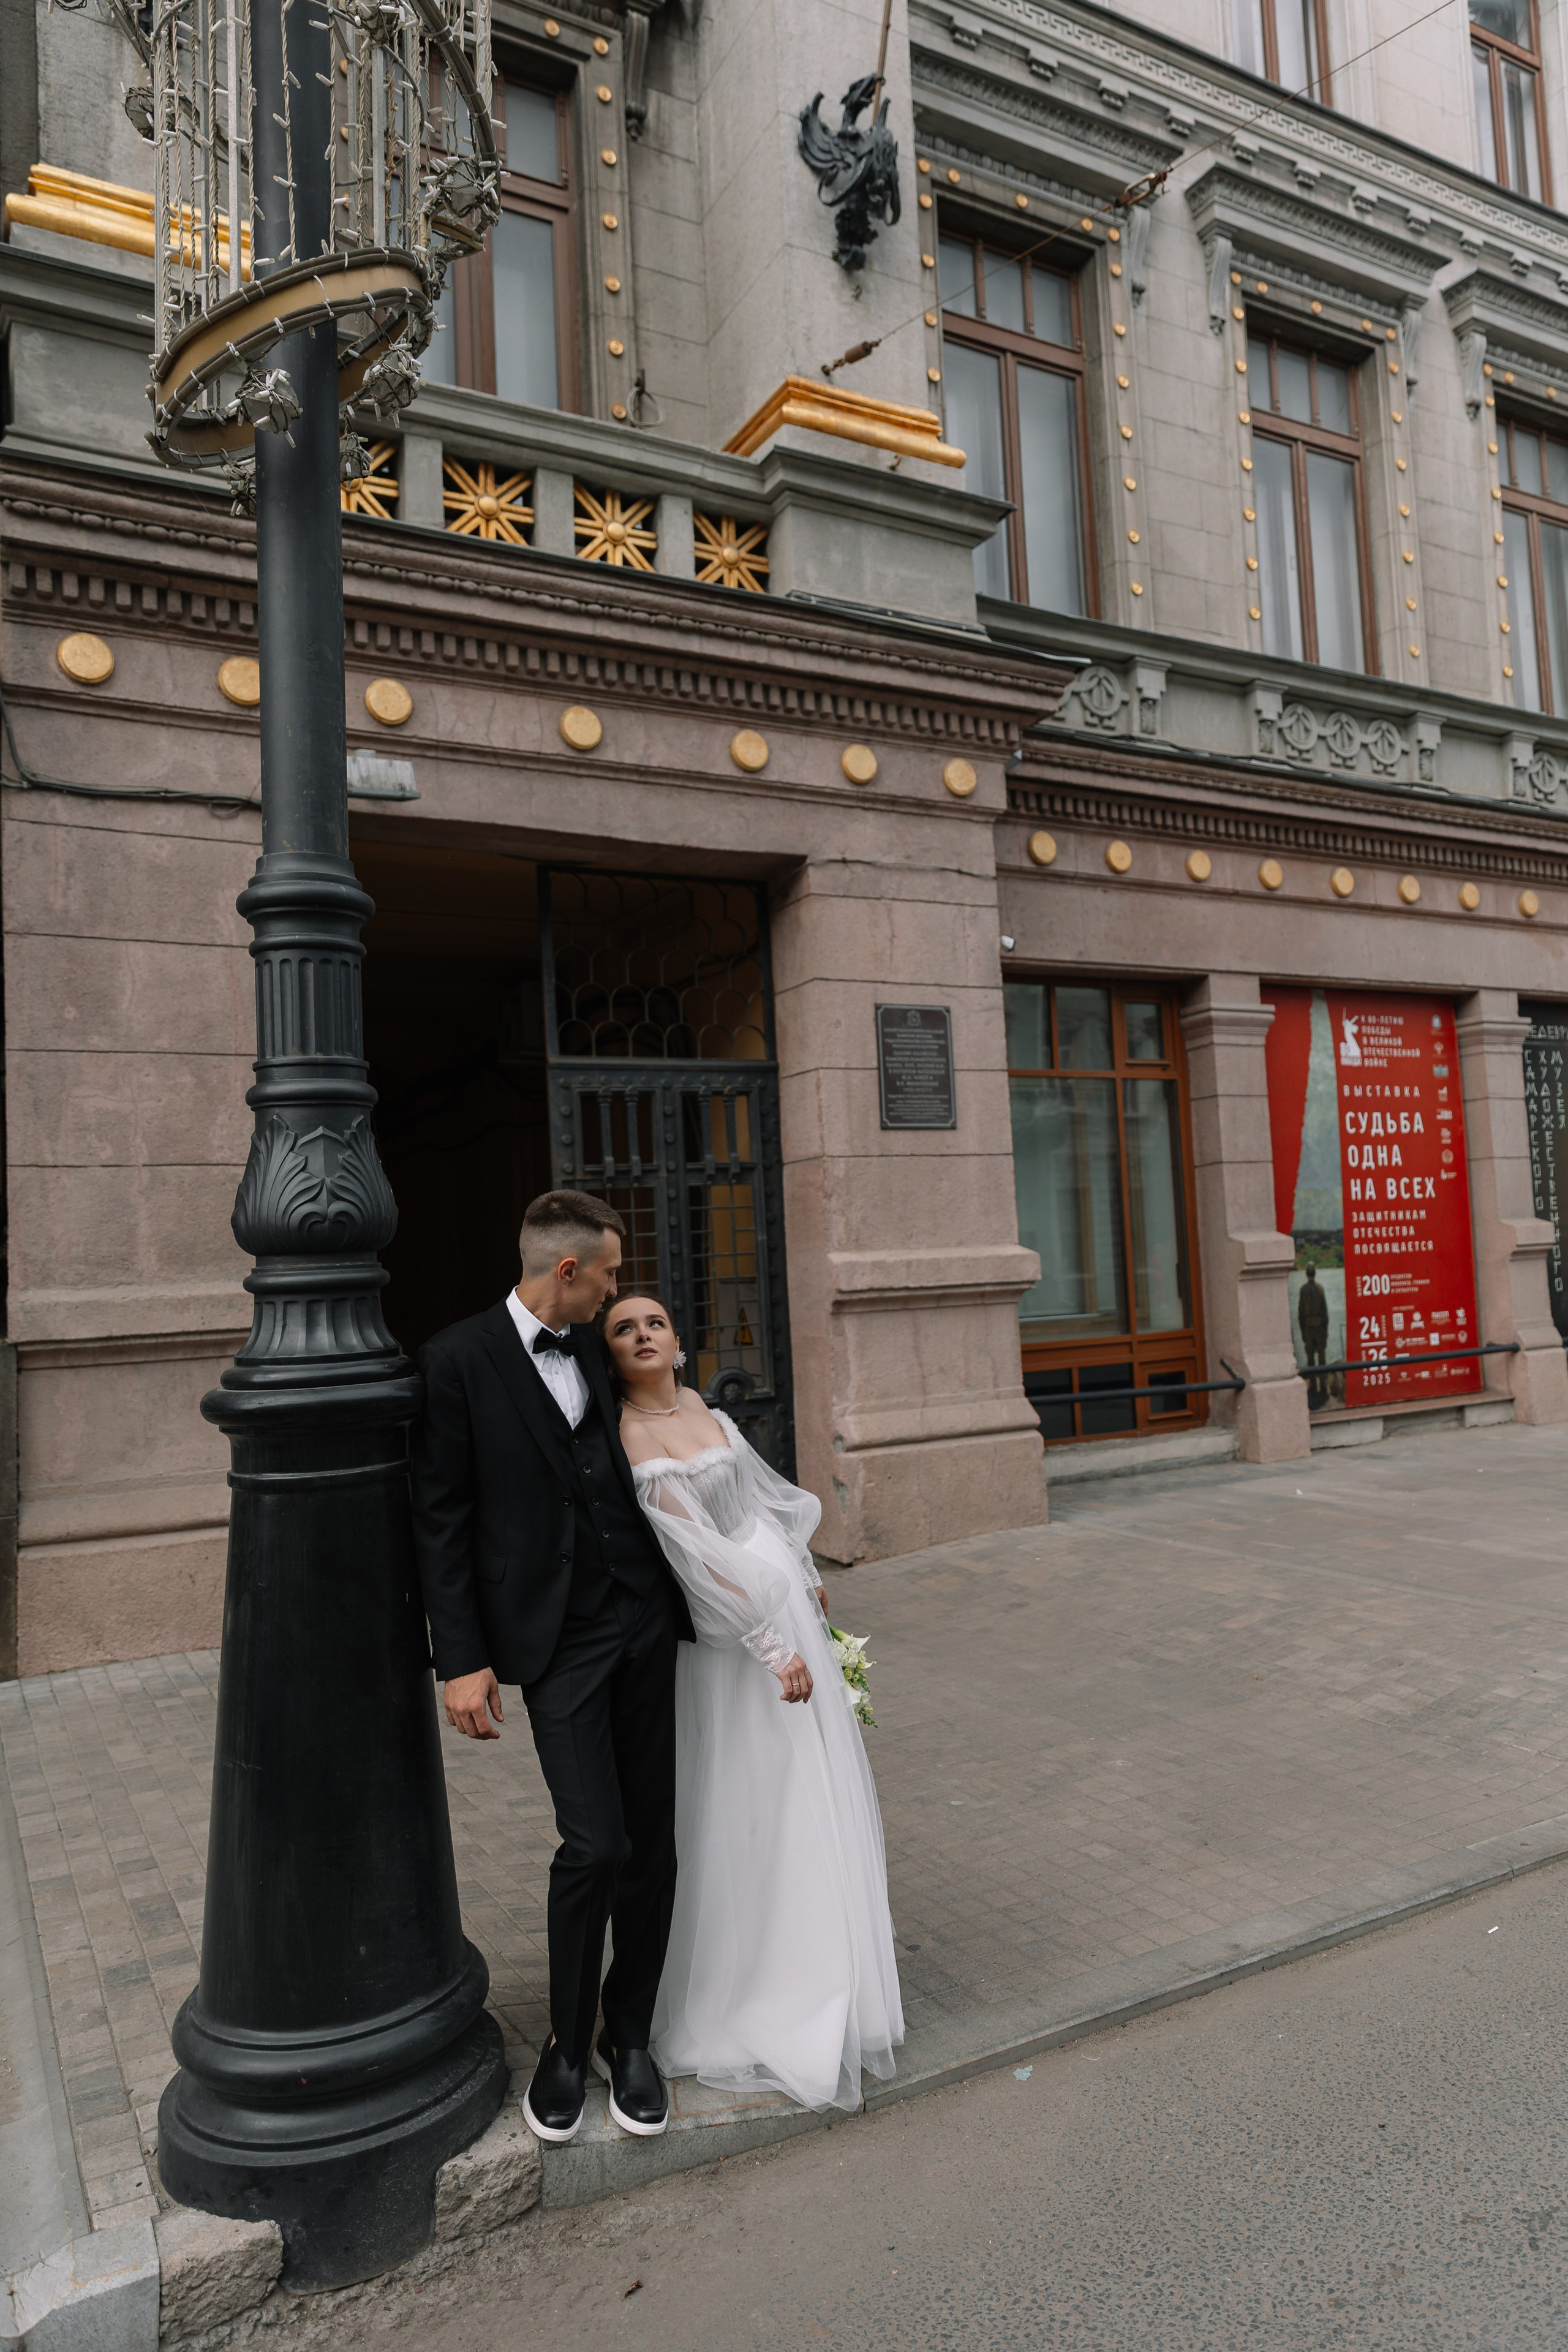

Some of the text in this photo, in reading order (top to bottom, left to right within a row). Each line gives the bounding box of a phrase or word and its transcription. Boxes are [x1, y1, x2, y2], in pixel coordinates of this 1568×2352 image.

[1362, 1025, 1391, 1035] ПОБЕДЫ
[1526, 1024, 1568, 1040] ЕДЕВР
[1362, 1036, 1403, 1046] В ВЕЛИКОЙ
[1363, 1047, 1420, 1057] ОТЕЧЕСТВЕННОЙ
[1364, 1058, 1388, 1068] ВОЙНЕ
[1343, 1084, 1420, 1098] ВЫСТАВКА
[1345, 1111, 1424, 1137] СУДЬБА
[1348, 1144, 1403, 1170] ОДНА
[1350, 1177, 1436, 1200] НА ВСЕХ
[1352, 1209, 1427, 1223] ЗАЩИТНИКАМ
[1352, 1225, 1415, 1239] ОТЕЧЕСТВА
[1354, 1240, 1433, 1255] ПОСВЯЩАЕТСЯ
[1362, 1274, 1390, 1296] 200
[1359, 1316, 1380, 1340] 24
[1368, 1347, 1389, 1372] 26
[1363, 1372, 1391, 1387] 2025
